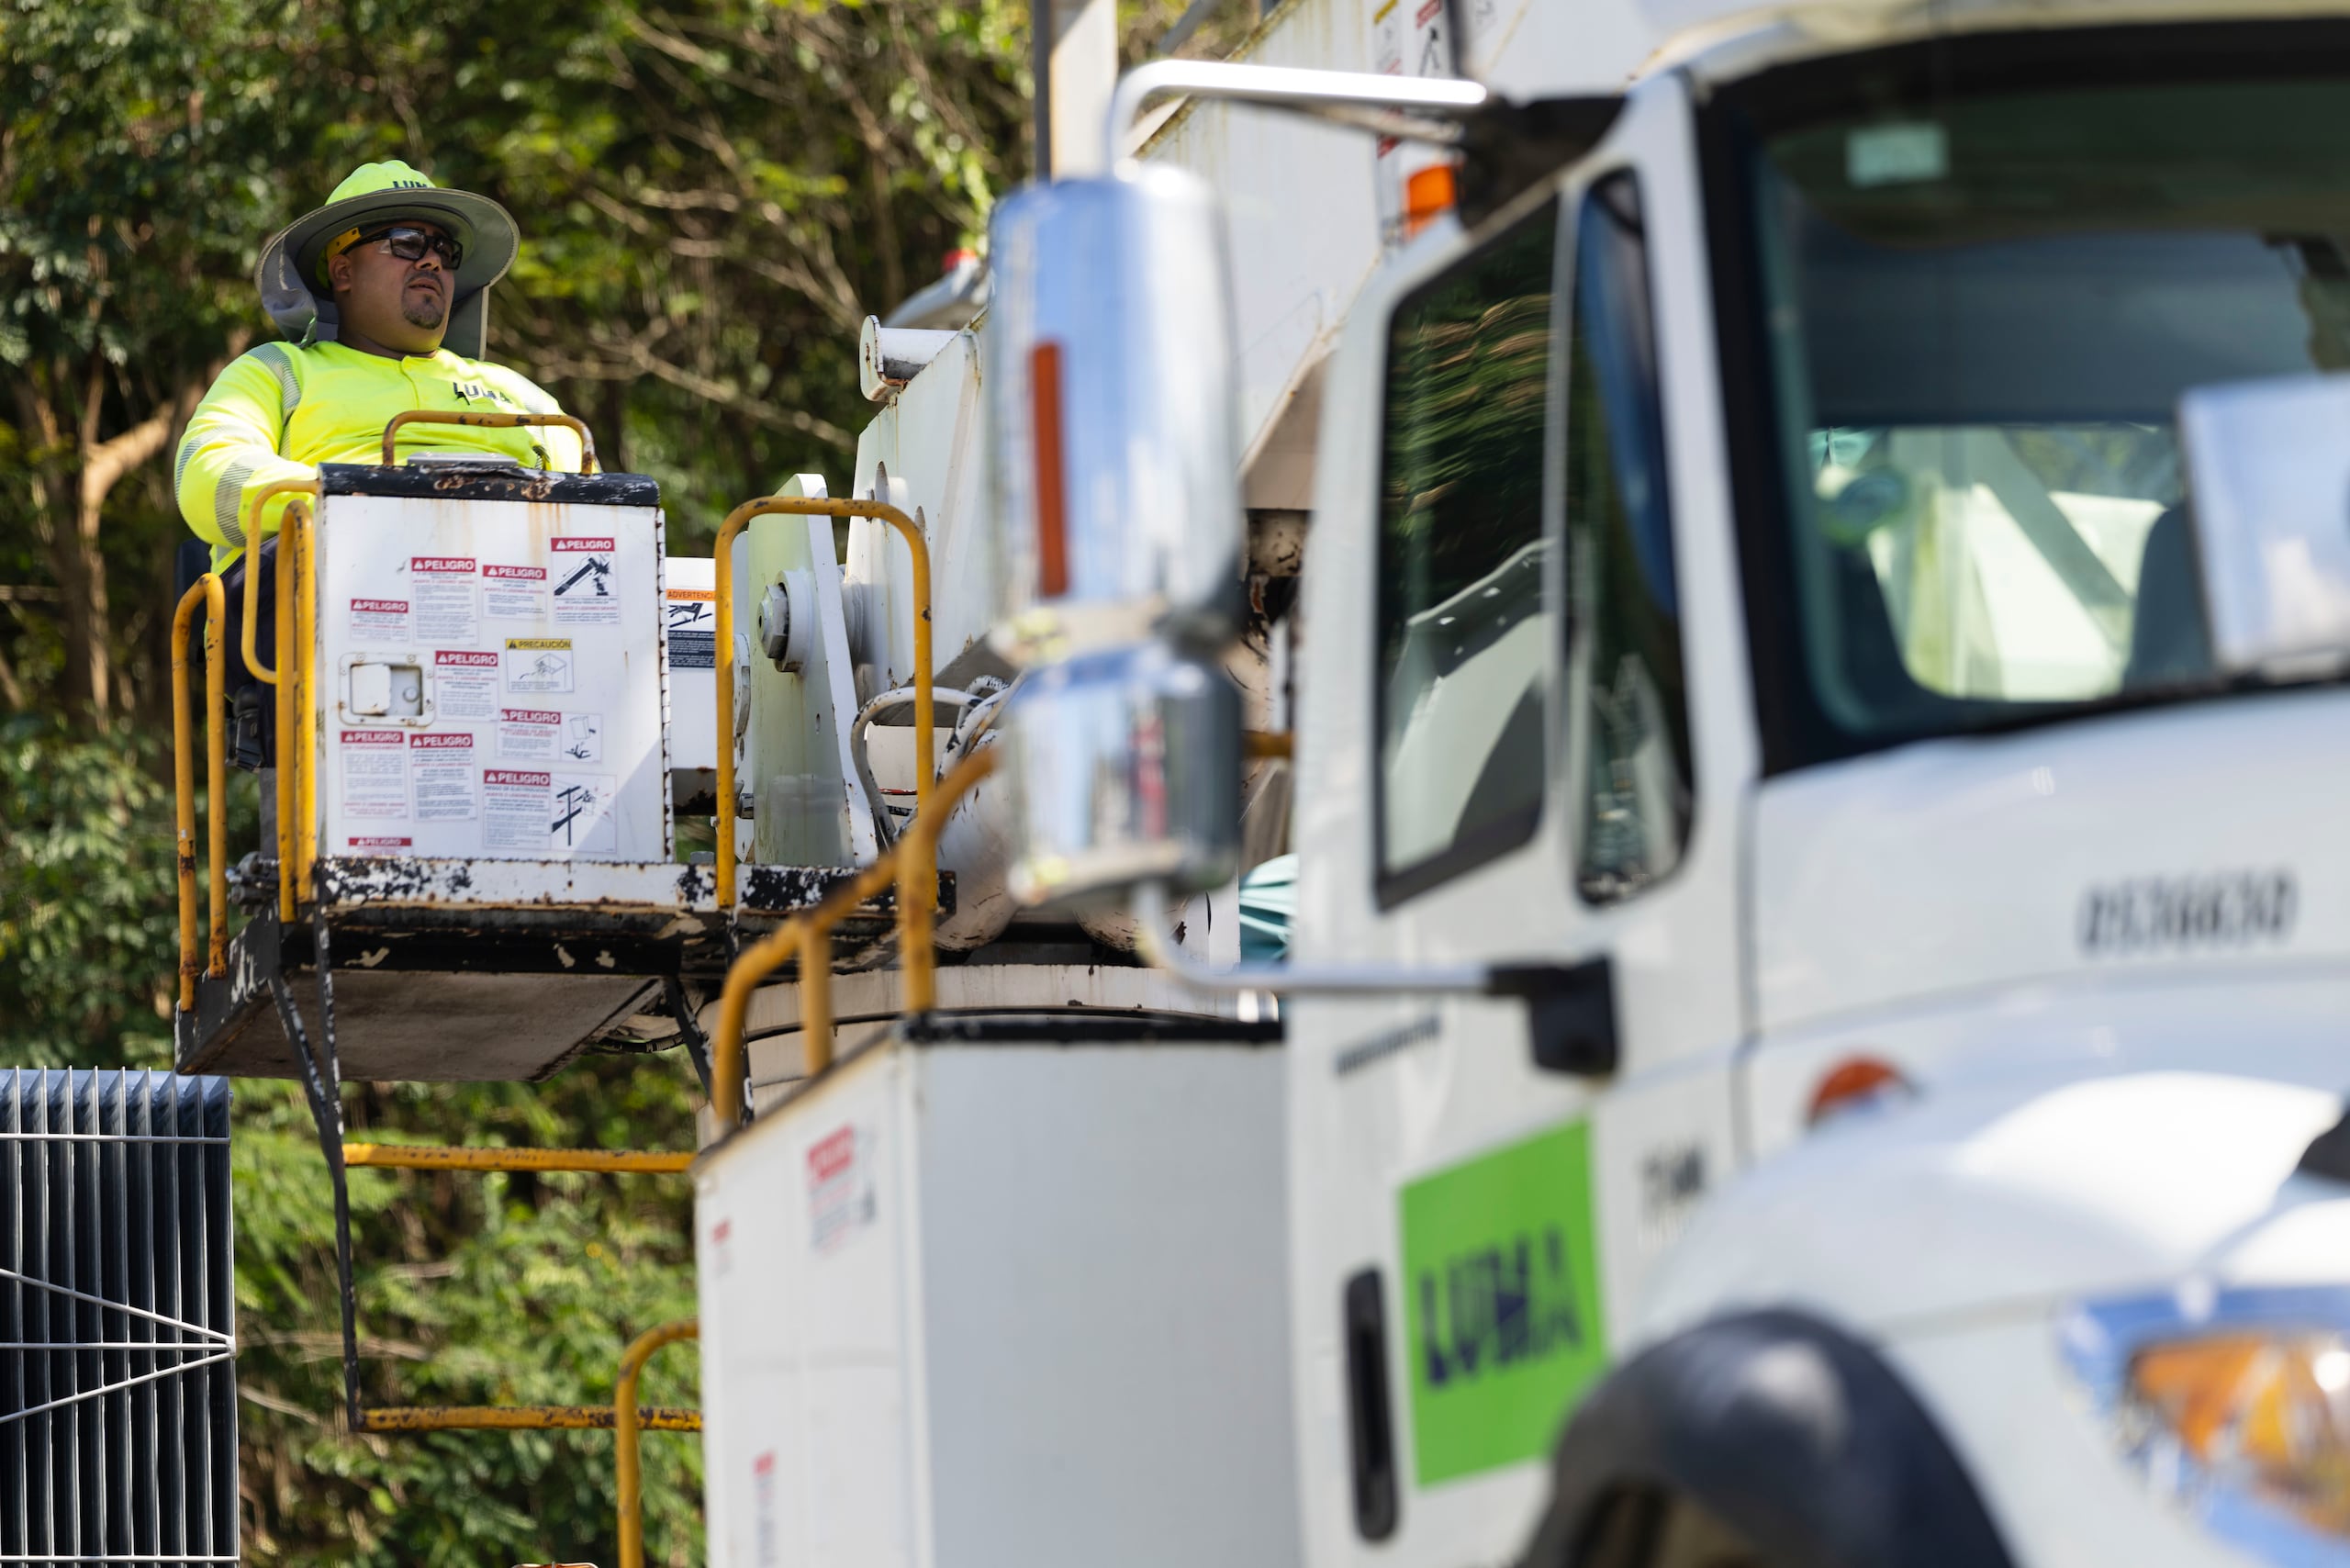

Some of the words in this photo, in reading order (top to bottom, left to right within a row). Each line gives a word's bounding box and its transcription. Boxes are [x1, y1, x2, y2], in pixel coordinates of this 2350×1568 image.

[567, 540, 612, 550] PELIGRO
[424, 560, 475, 571] PELIGRO
[498, 567, 544, 579] PELIGRO
[667, 590, 716, 599] ADVERTENCI
[363, 600, 407, 611] PELIGRO
[519, 639, 571, 648] PRECAUCIÓN
[447, 654, 498, 665] PELIGRO
[509, 711, 560, 723] PELIGRO
[353, 732, 401, 743] PELIGRO
[423, 735, 472, 747] PELIGRO
[498, 772, 550, 786] PELIGRO
